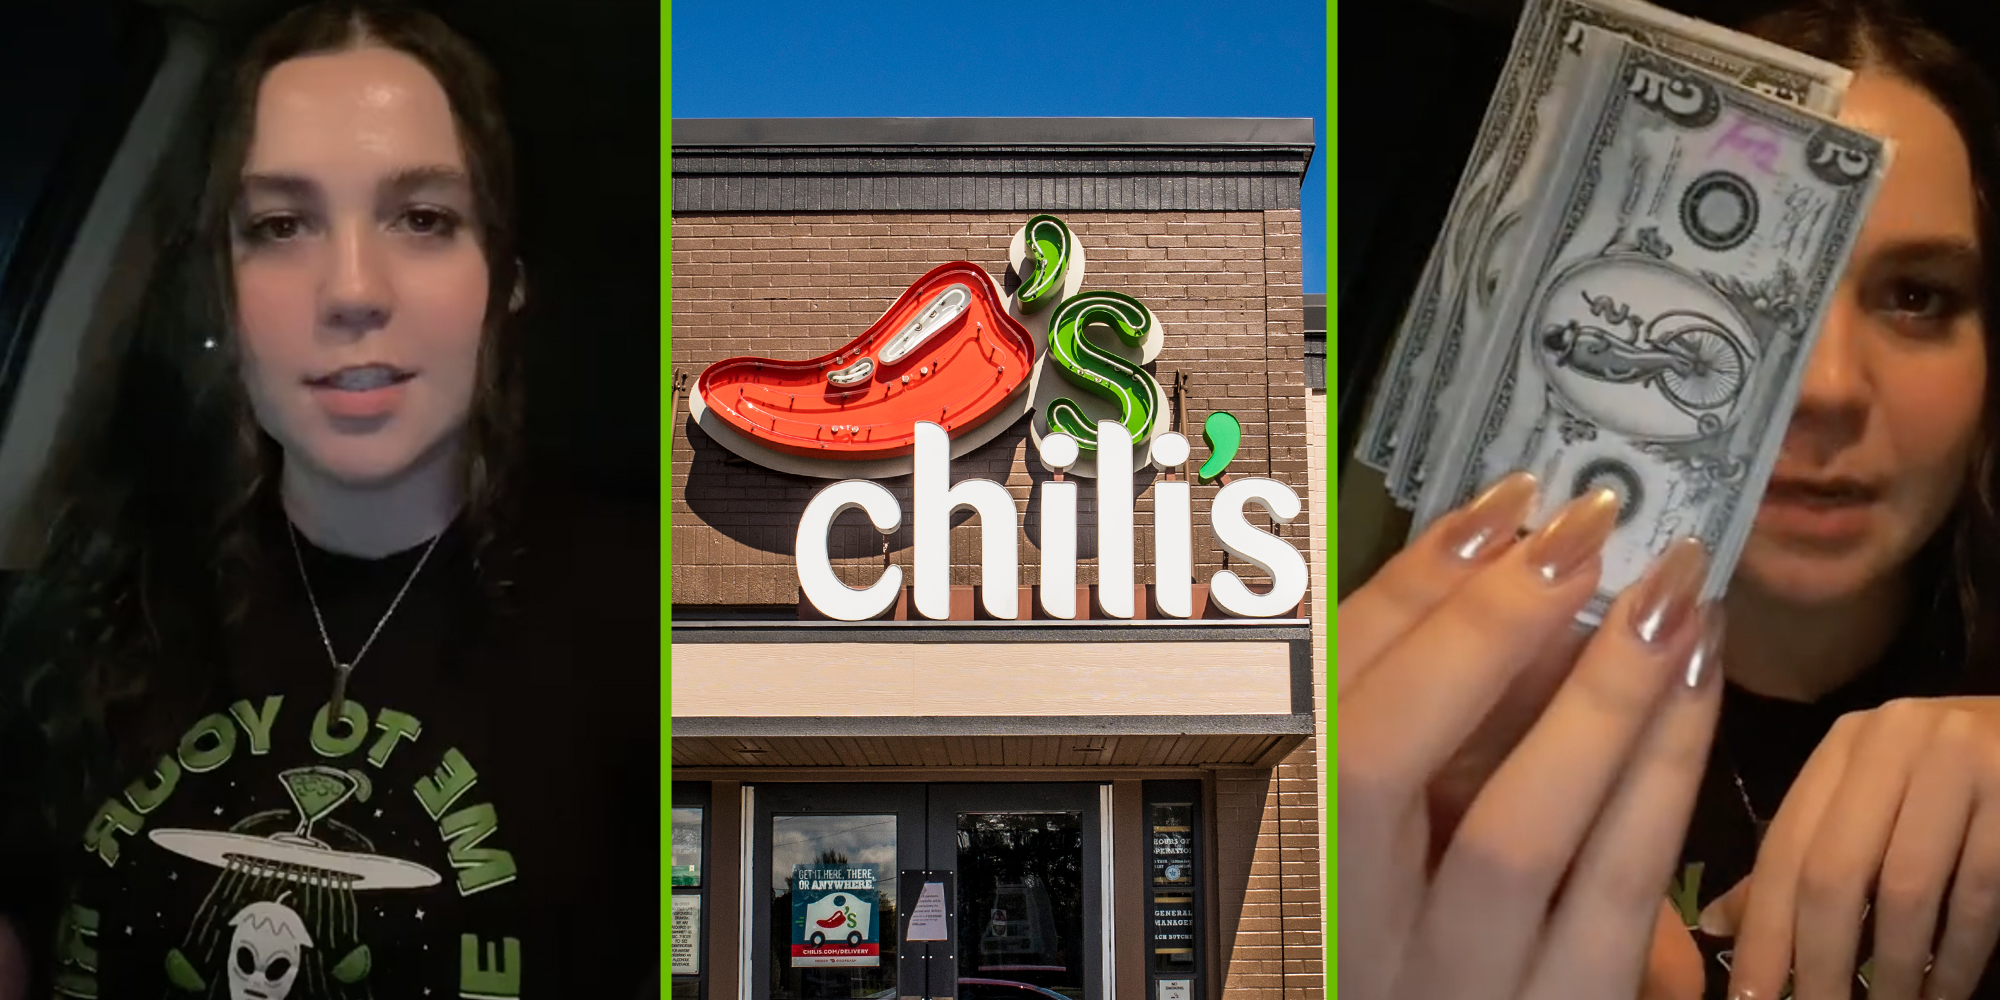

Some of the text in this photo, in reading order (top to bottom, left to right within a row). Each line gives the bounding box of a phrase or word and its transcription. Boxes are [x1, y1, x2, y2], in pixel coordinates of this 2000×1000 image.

[795, 411, 1309, 621] chili's
[798, 868, 876, 881] GET IT HERE, THERE,
[799, 880, 875, 890] OR ANYWHERE.
[1154, 909, 1193, 917] GENERAL
